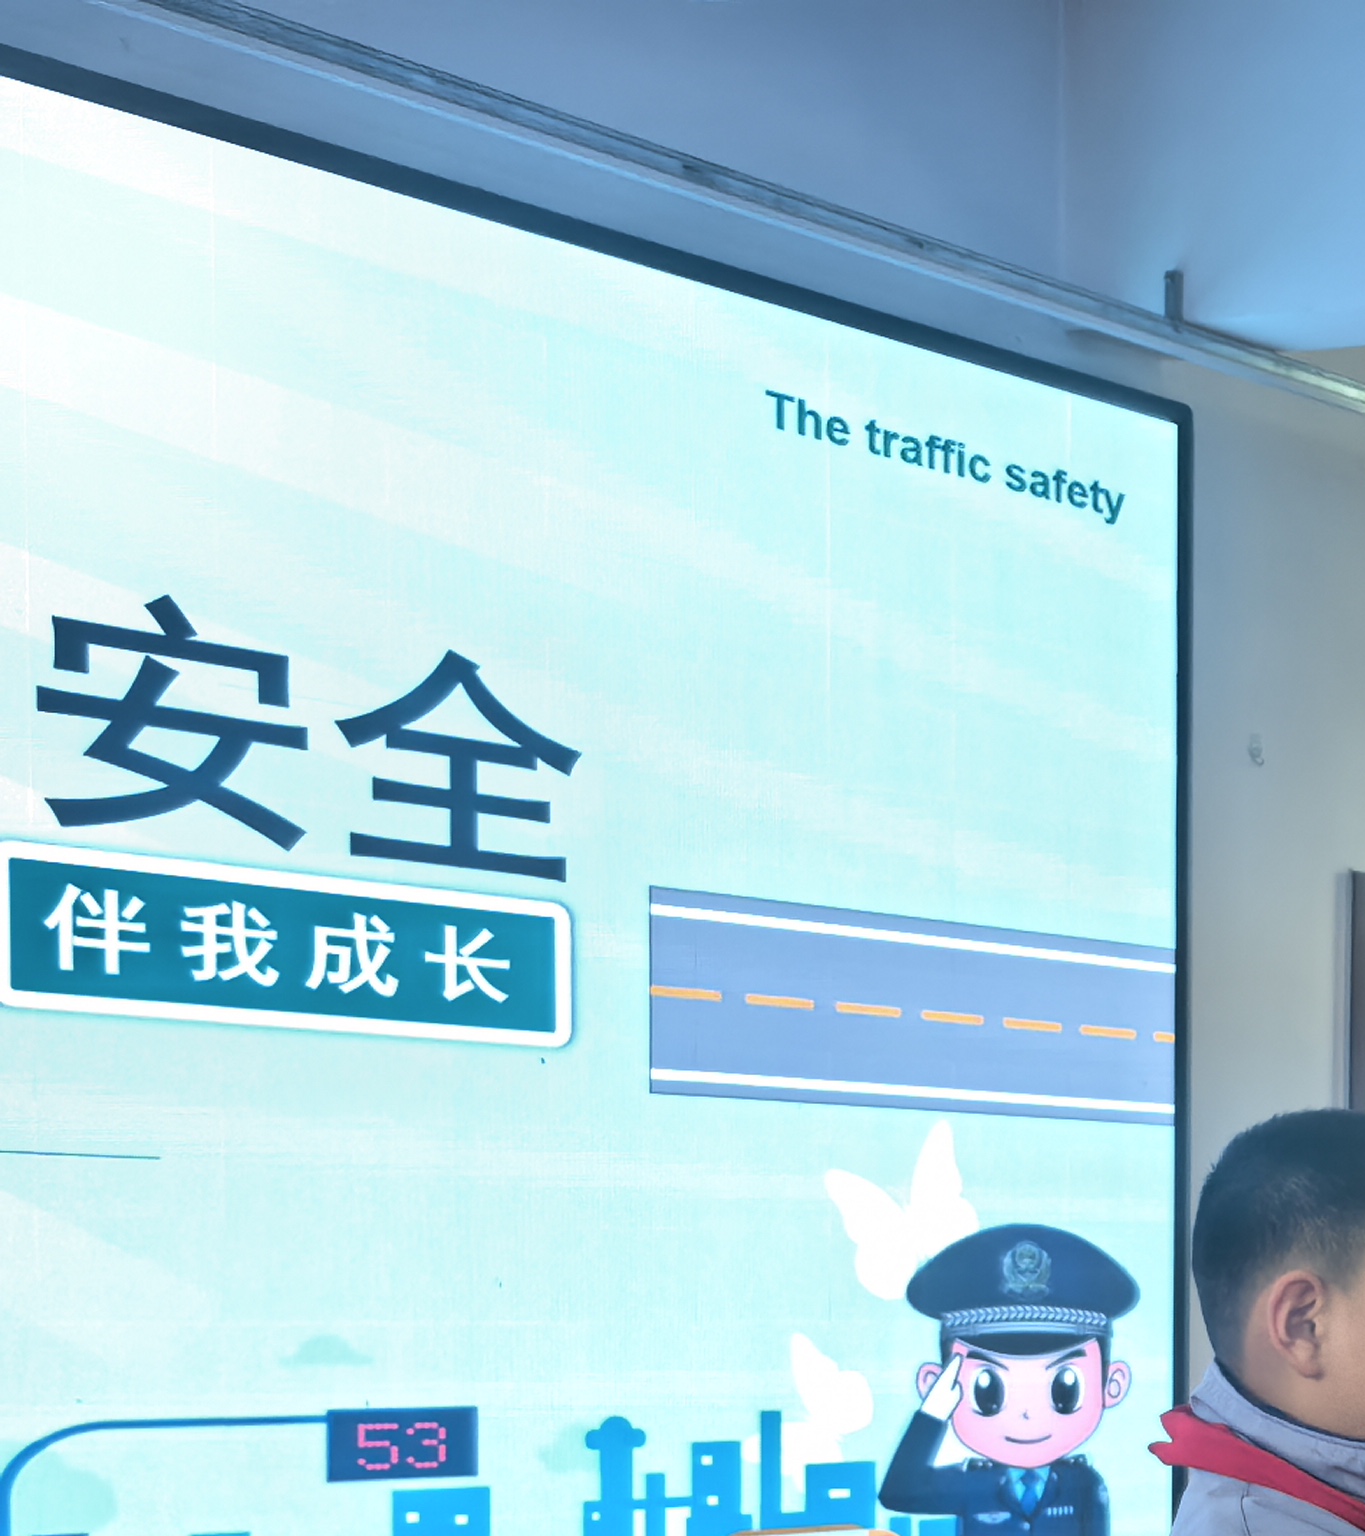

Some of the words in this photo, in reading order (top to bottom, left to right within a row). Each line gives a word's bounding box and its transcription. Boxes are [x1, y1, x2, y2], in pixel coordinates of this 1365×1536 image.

[764, 389, 851, 447] The
[864, 416, 993, 484] traffic
[1004, 461, 1126, 525] safety
[35, 594, 583, 884] 安全
[43, 882, 512, 1003] 伴我成长
[355, 1420, 448, 1471] 53
